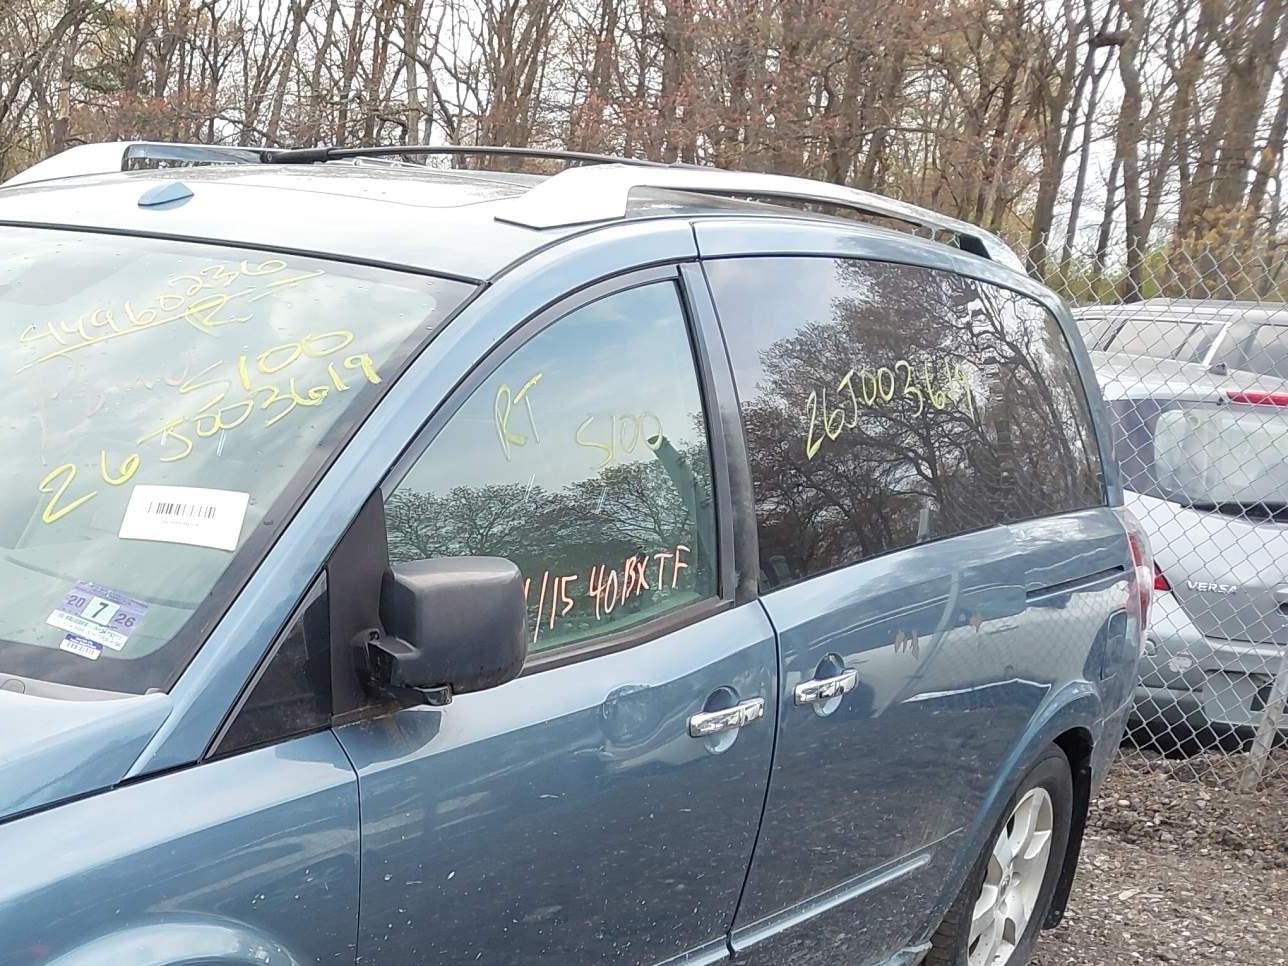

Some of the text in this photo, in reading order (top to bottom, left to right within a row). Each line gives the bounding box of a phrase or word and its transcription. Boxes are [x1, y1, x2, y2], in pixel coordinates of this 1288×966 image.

[1187, 580, 1239, 594] VERSA
[91, 601, 109, 618] 7
[114, 612, 137, 628] 26
